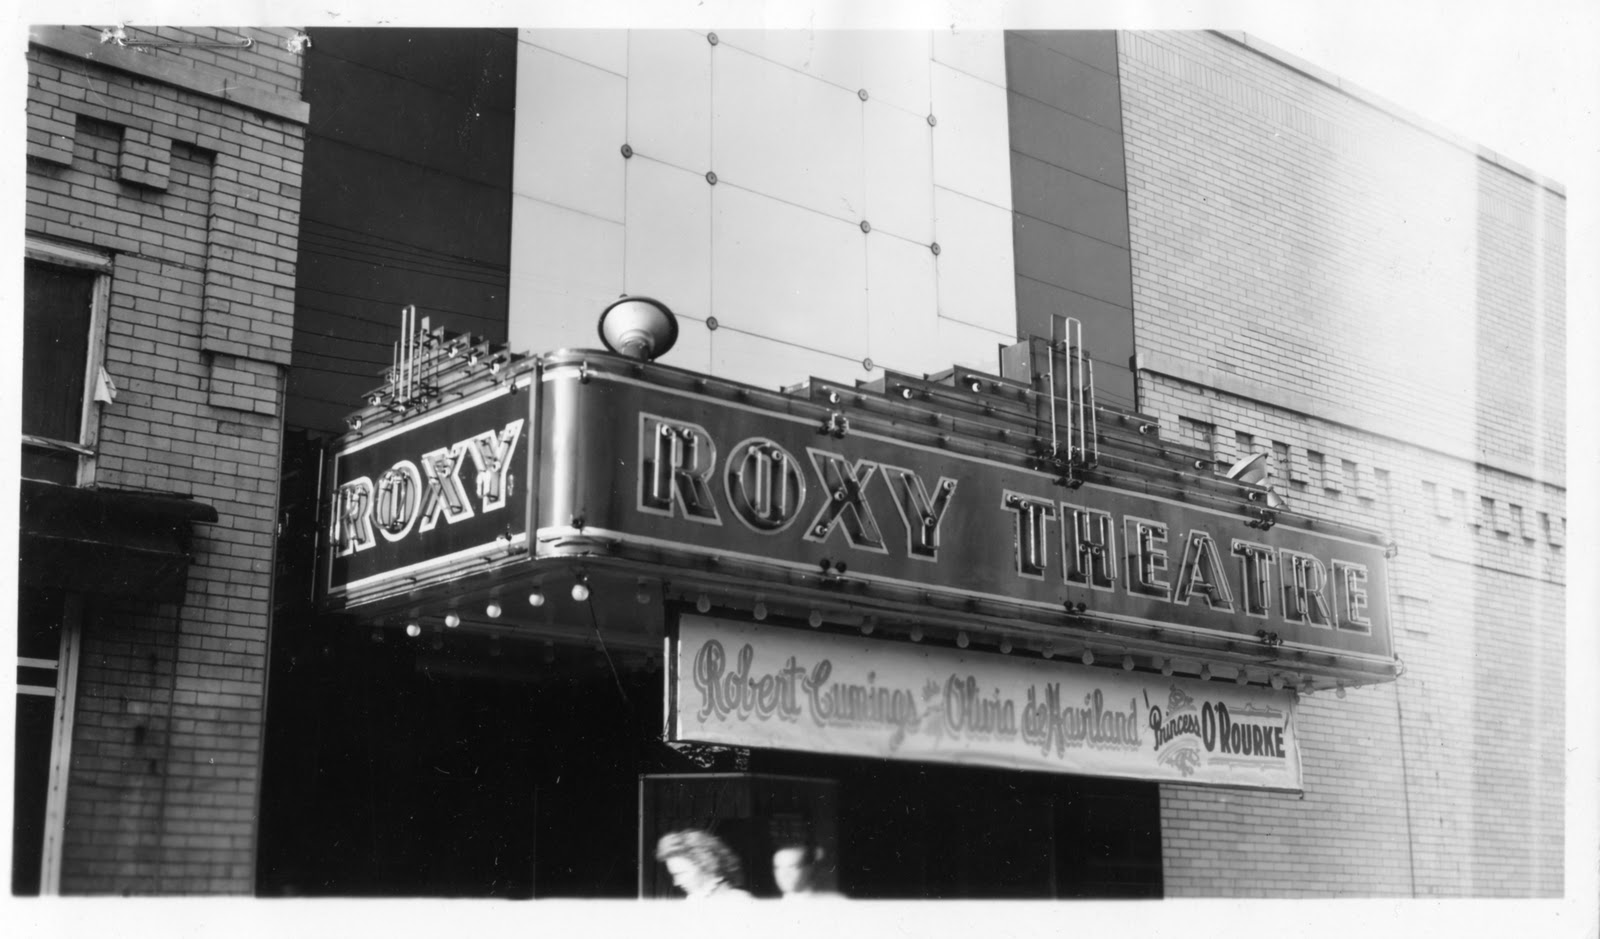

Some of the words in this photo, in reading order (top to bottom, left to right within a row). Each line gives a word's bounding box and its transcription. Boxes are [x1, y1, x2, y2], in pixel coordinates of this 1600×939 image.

[331, 418, 525, 559] ROXY
[637, 410, 958, 562] ROXY
[1000, 488, 1372, 637] THEATRE
[693, 638, 806, 723] Robert
[944, 673, 1018, 741] Olivia
